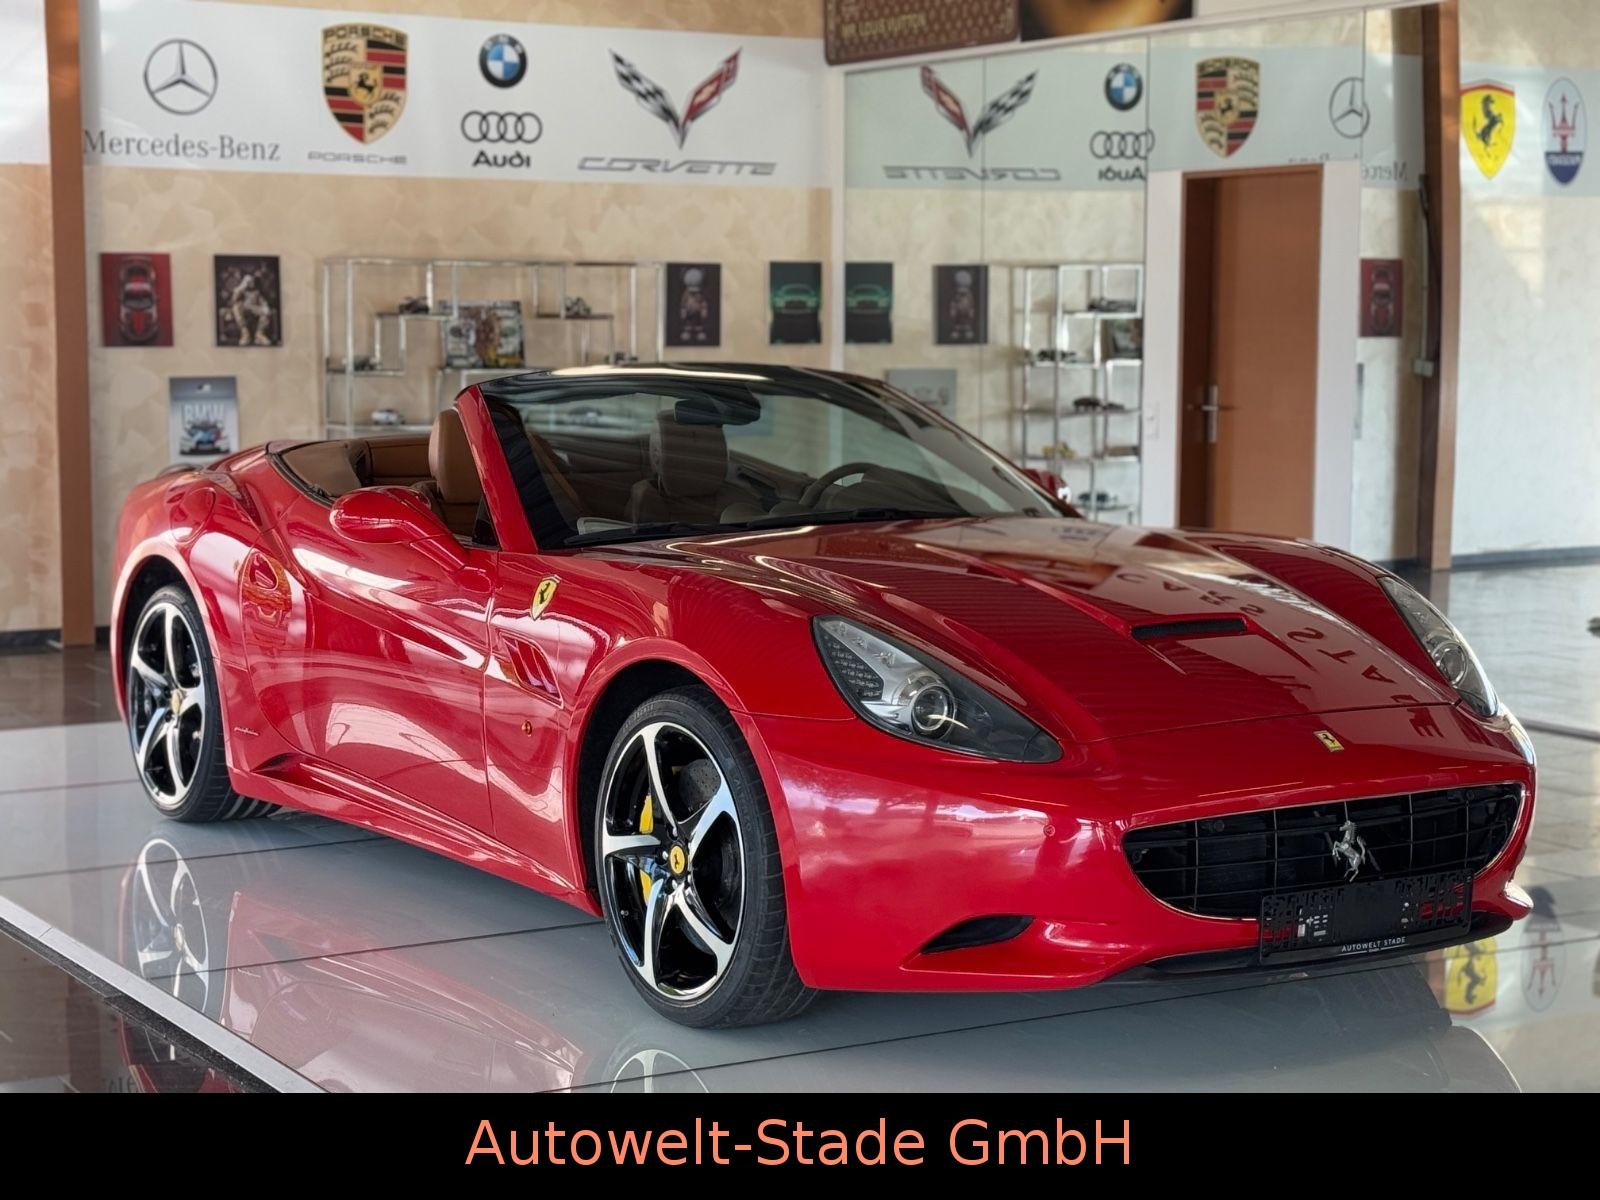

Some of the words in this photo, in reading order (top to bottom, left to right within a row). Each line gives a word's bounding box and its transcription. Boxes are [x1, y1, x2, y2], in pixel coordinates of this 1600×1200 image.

[84, 129, 281, 162] Mercedes-Benz
[308, 151, 407, 165] PORSCHE
[472, 150, 531, 168] Audi
[577, 156, 777, 176] CORVETTE
[1341, 940, 1381, 953] AUTOWELT
[1383, 936, 1406, 946] STADE
